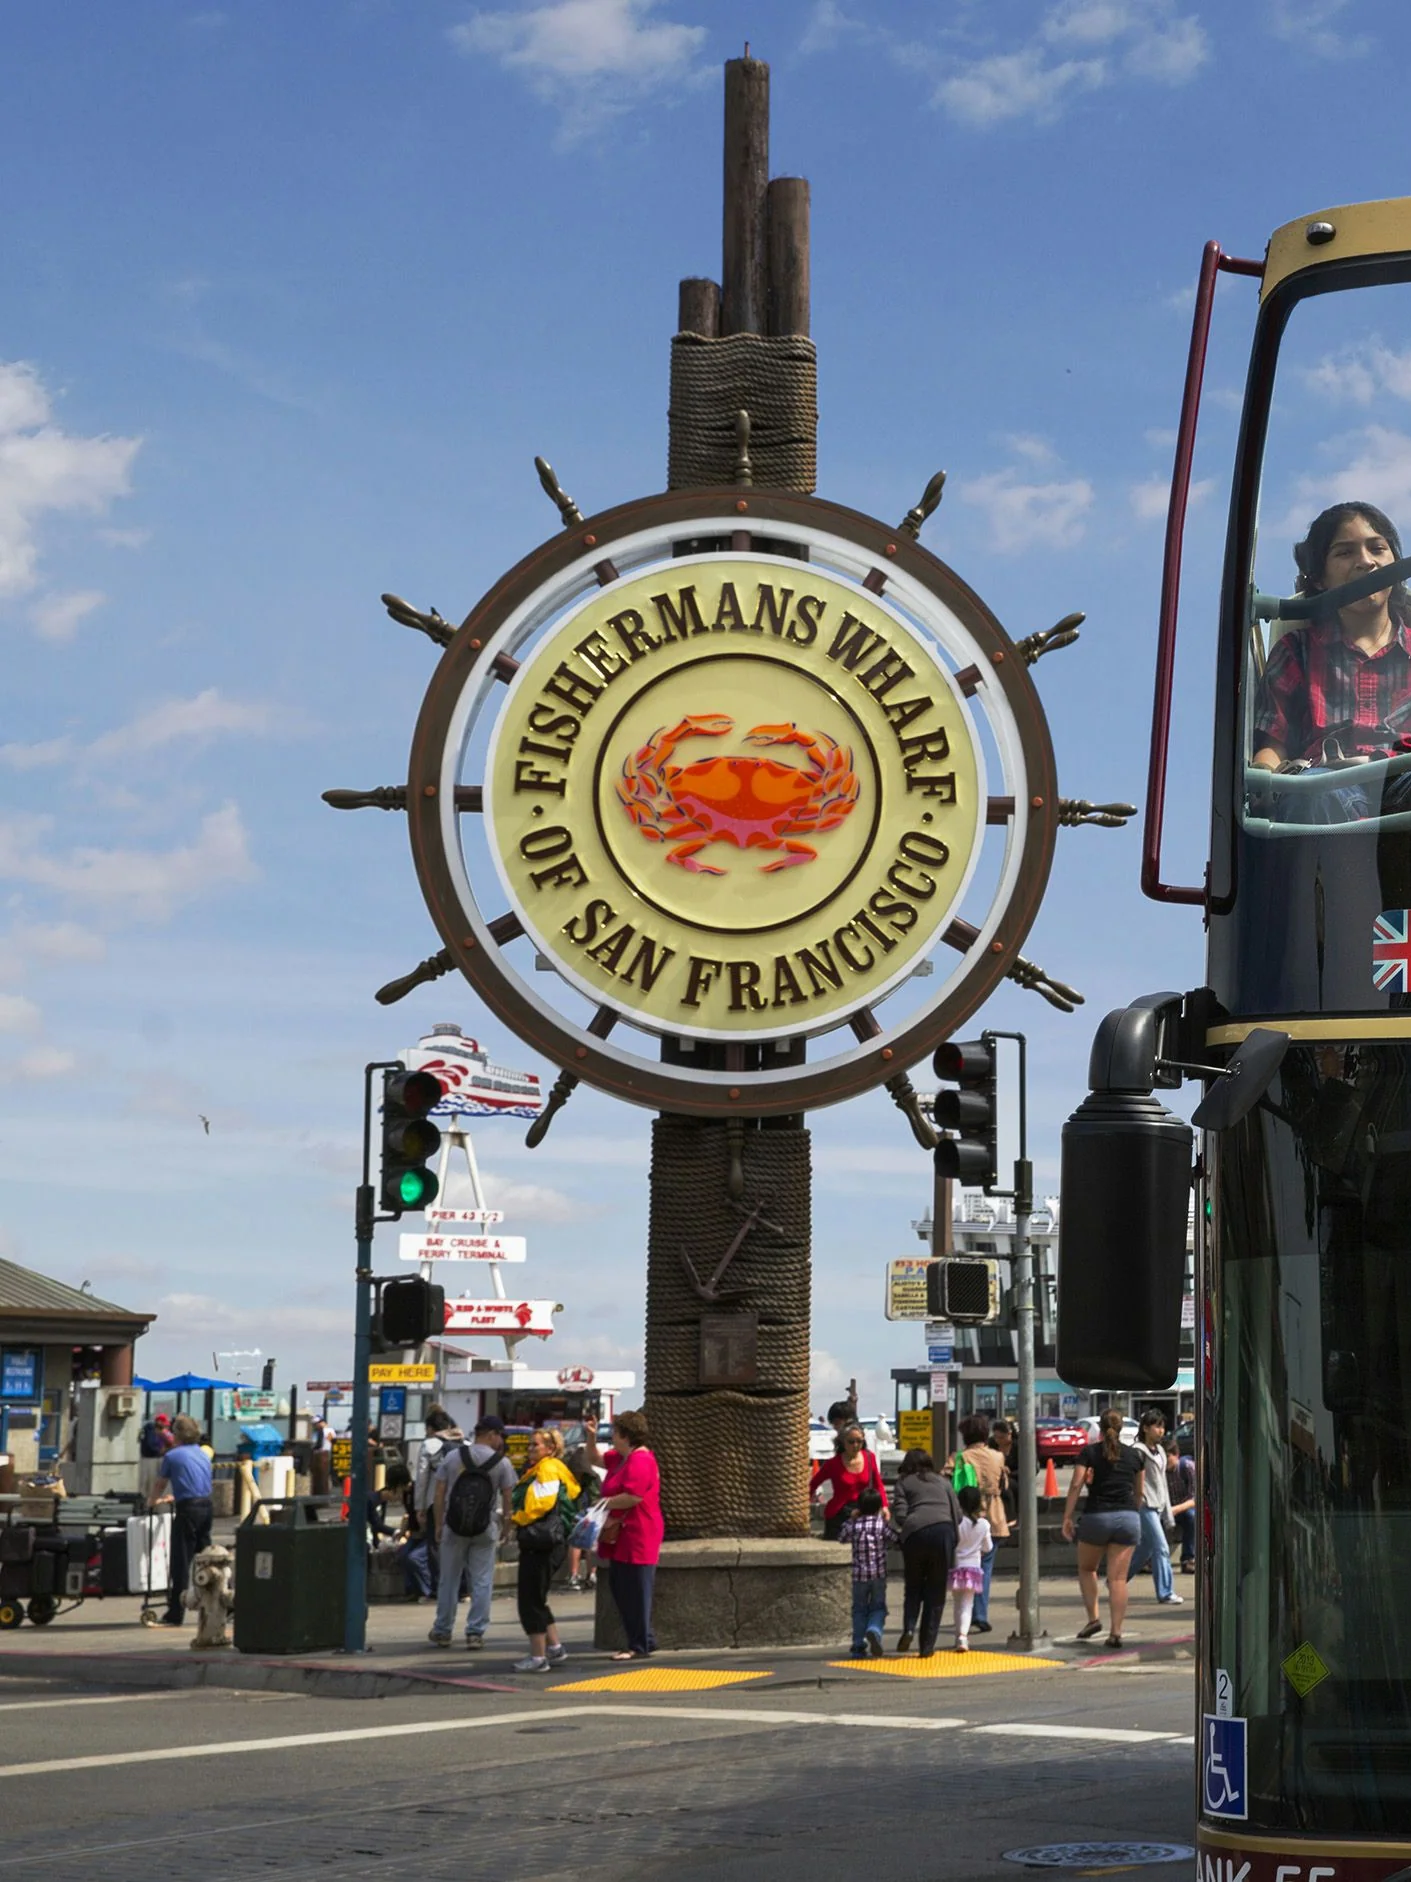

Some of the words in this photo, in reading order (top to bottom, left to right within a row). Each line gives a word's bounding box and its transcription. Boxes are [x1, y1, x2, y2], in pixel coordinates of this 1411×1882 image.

[514, 582, 826, 798] FISHERMANS
[825, 611, 958, 805] WHARF
[520, 825, 589, 892] OF
[561, 898, 675, 993] SAN
[680, 831, 951, 1013] FRANCISCO
[431, 1211, 456, 1220] PIER
[426, 1238, 444, 1247] BAY
[450, 1239, 488, 1248] CRUISE
[418, 1249, 451, 1259] FERRY
[458, 1250, 507, 1260] TERMINAL
[471, 1316, 497, 1324] FLEET
[372, 1367, 393, 1377] PAY
[398, 1367, 432, 1378] HERE
[1219, 1673, 1228, 1700] 2
